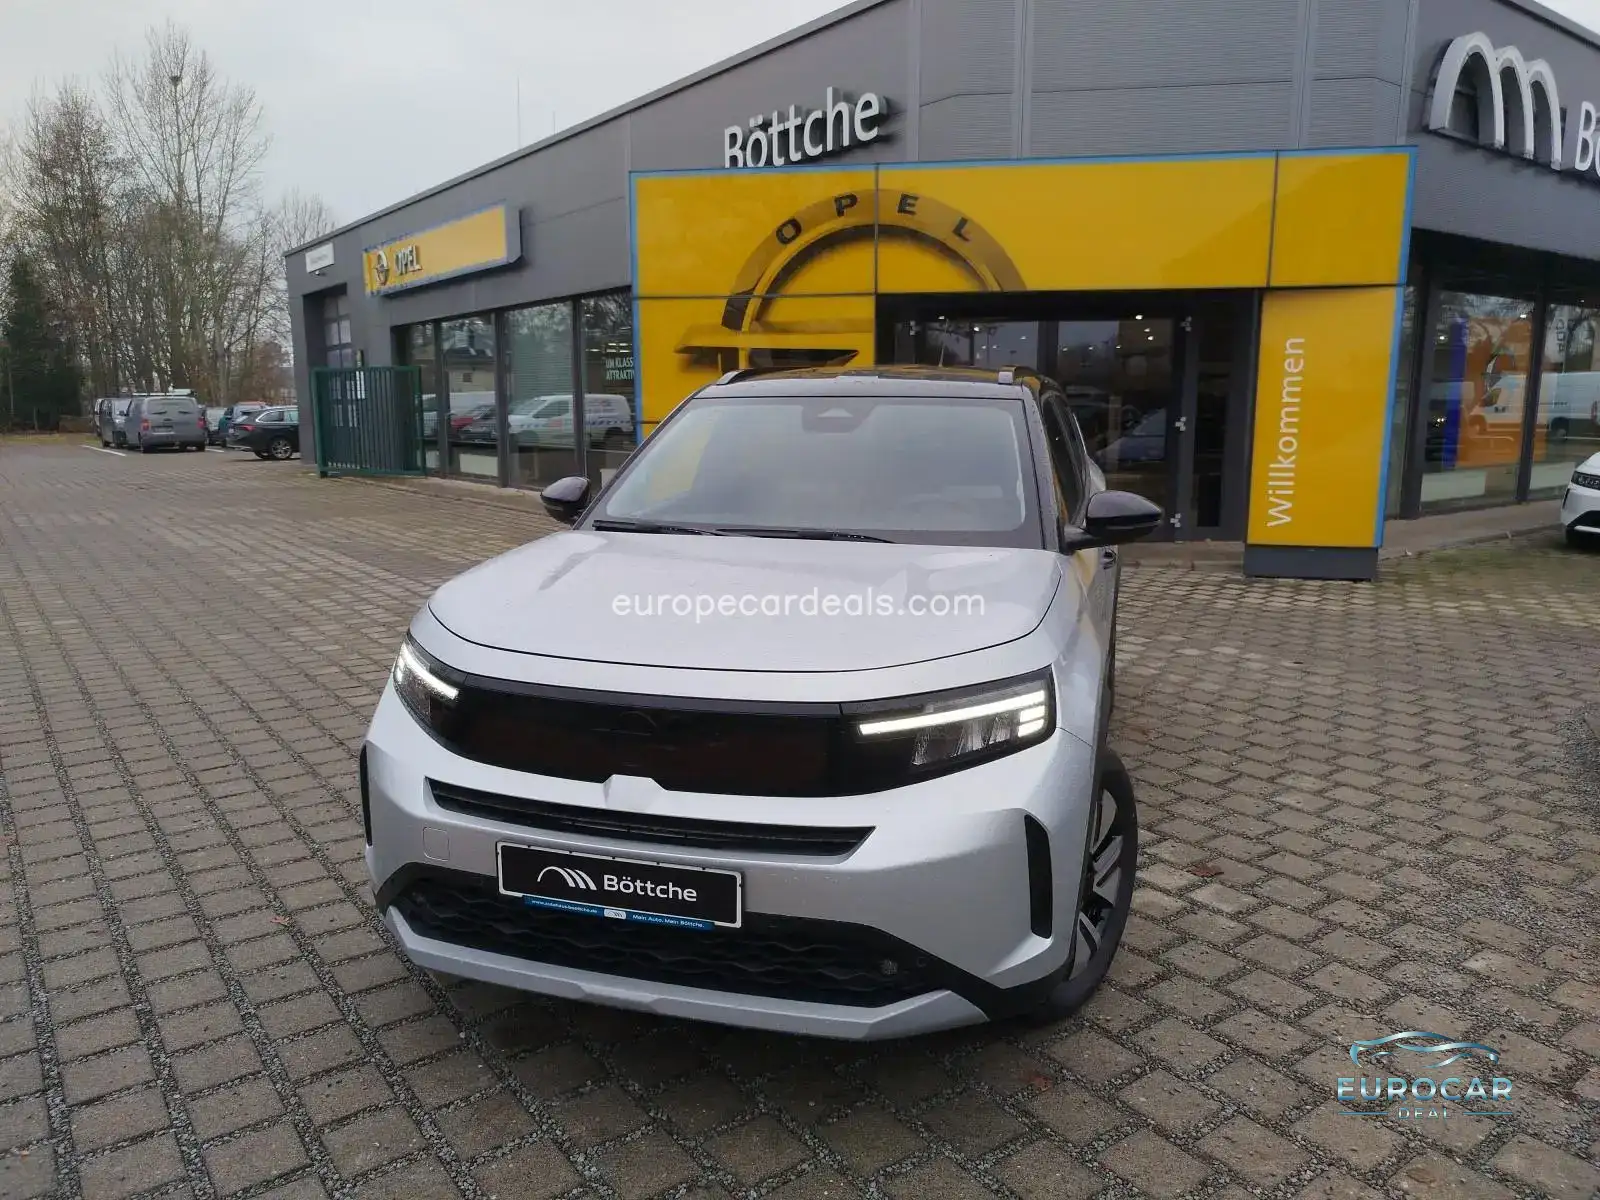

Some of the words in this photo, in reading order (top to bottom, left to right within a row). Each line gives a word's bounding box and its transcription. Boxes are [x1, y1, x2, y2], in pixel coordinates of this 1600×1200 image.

[724, 86, 880, 168] Böttche
[1575, 101, 1600, 178] B
[775, 192, 972, 246] OPEL
[395, 244, 422, 275] OPEL
[1266, 337, 1305, 527] Willkommen
[603, 874, 697, 902] Böttche
